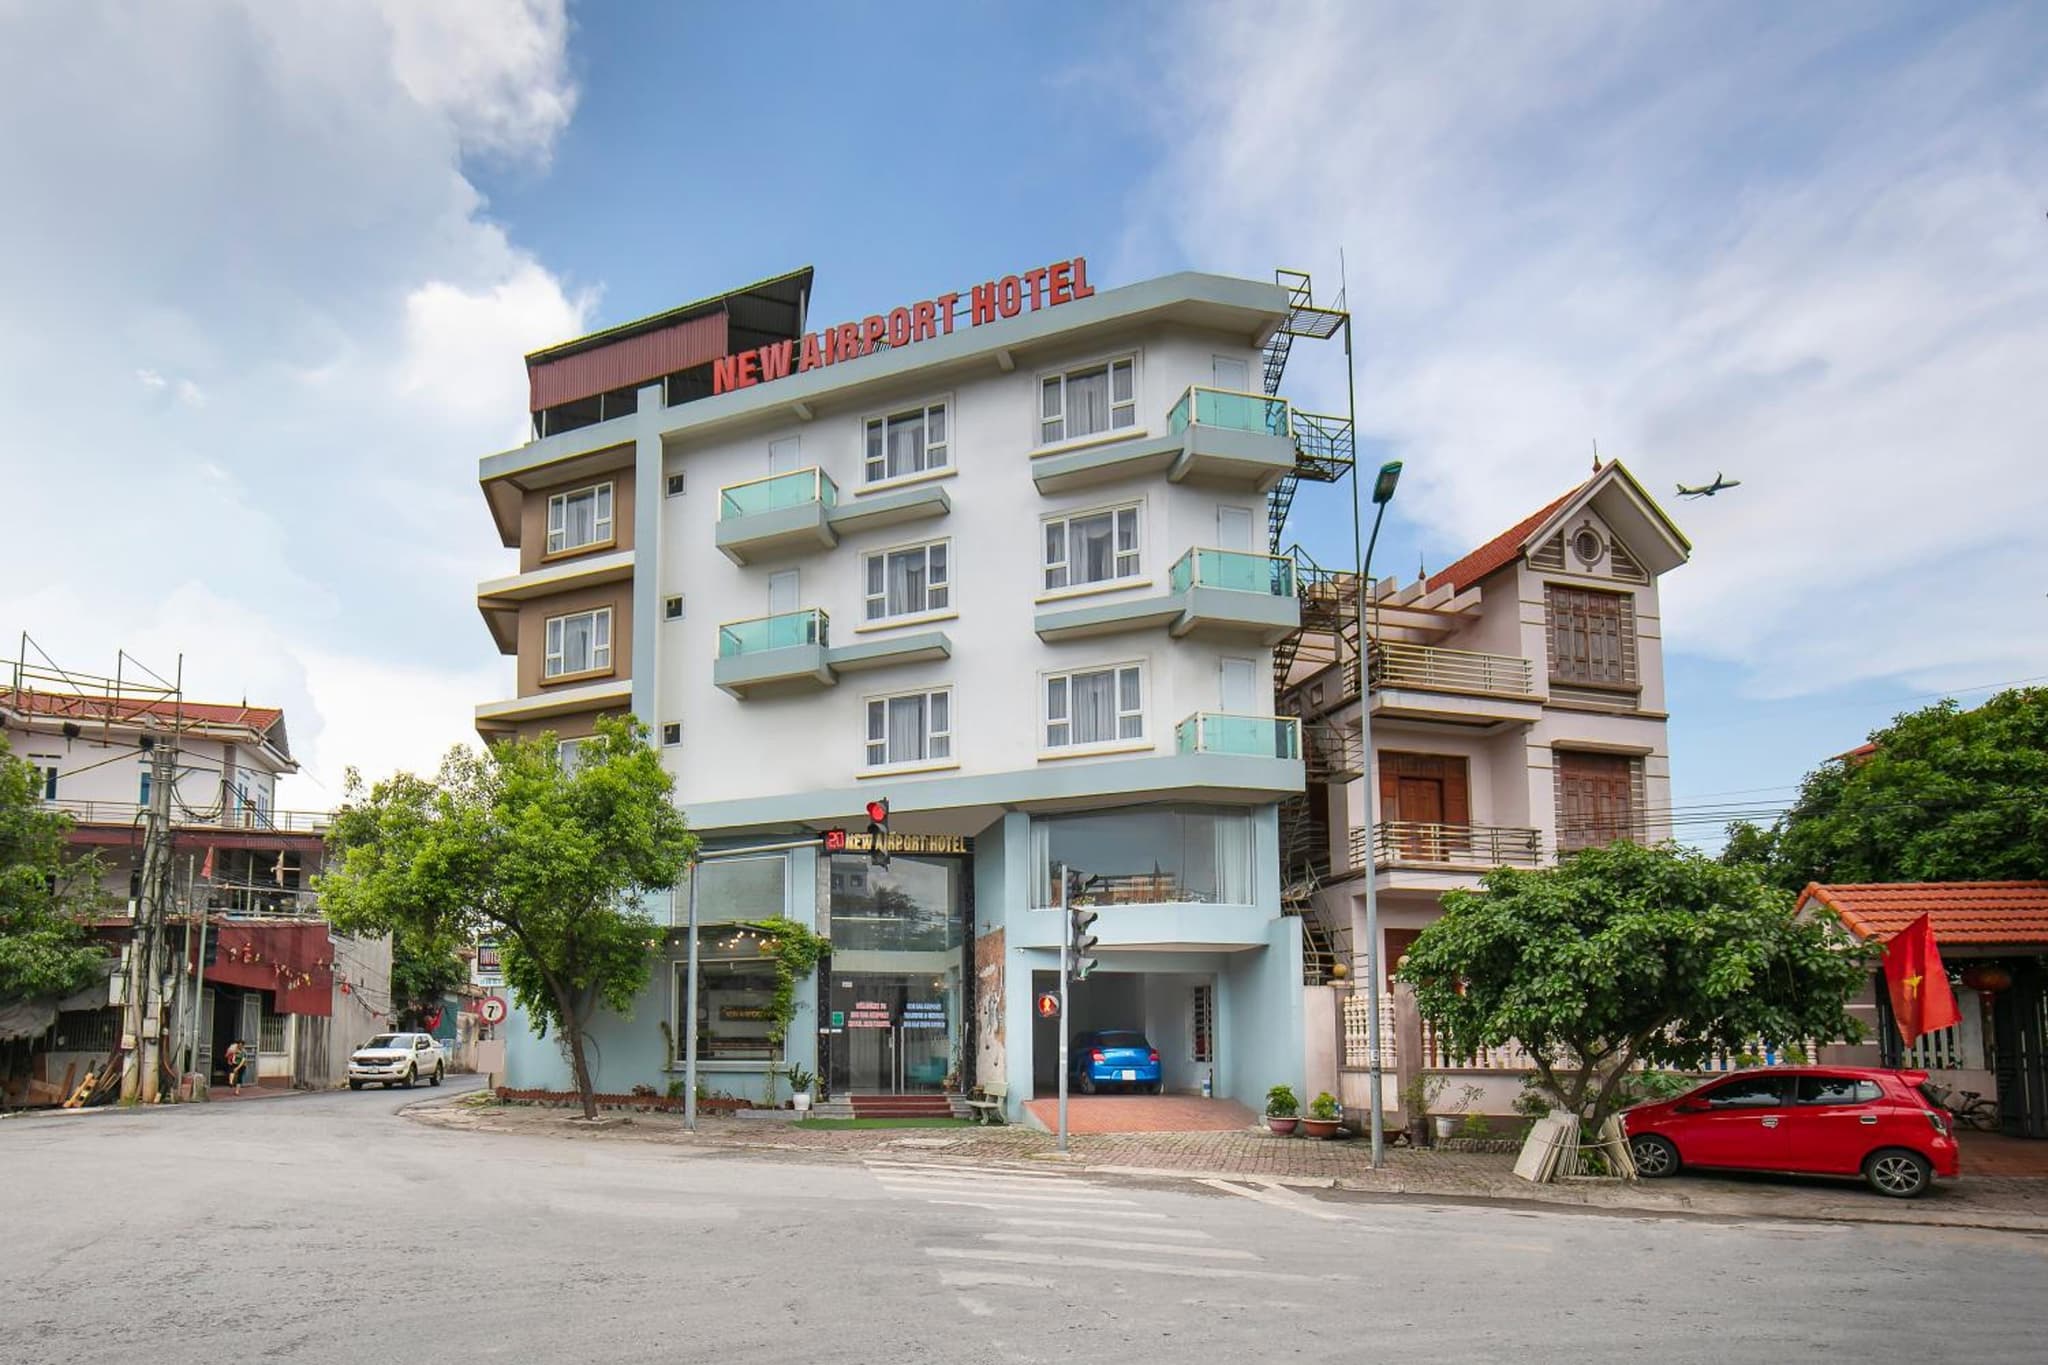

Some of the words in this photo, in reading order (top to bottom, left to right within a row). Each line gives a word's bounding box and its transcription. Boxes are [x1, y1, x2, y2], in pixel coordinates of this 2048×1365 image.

[713, 339, 793, 395] NEW
[799, 293, 959, 373] AIRPORT
[971, 257, 1095, 327] HOTEL
[845, 833, 873, 850] NEW
[875, 832, 927, 852] AIRPORT
[930, 834, 967, 852] HOTEL
